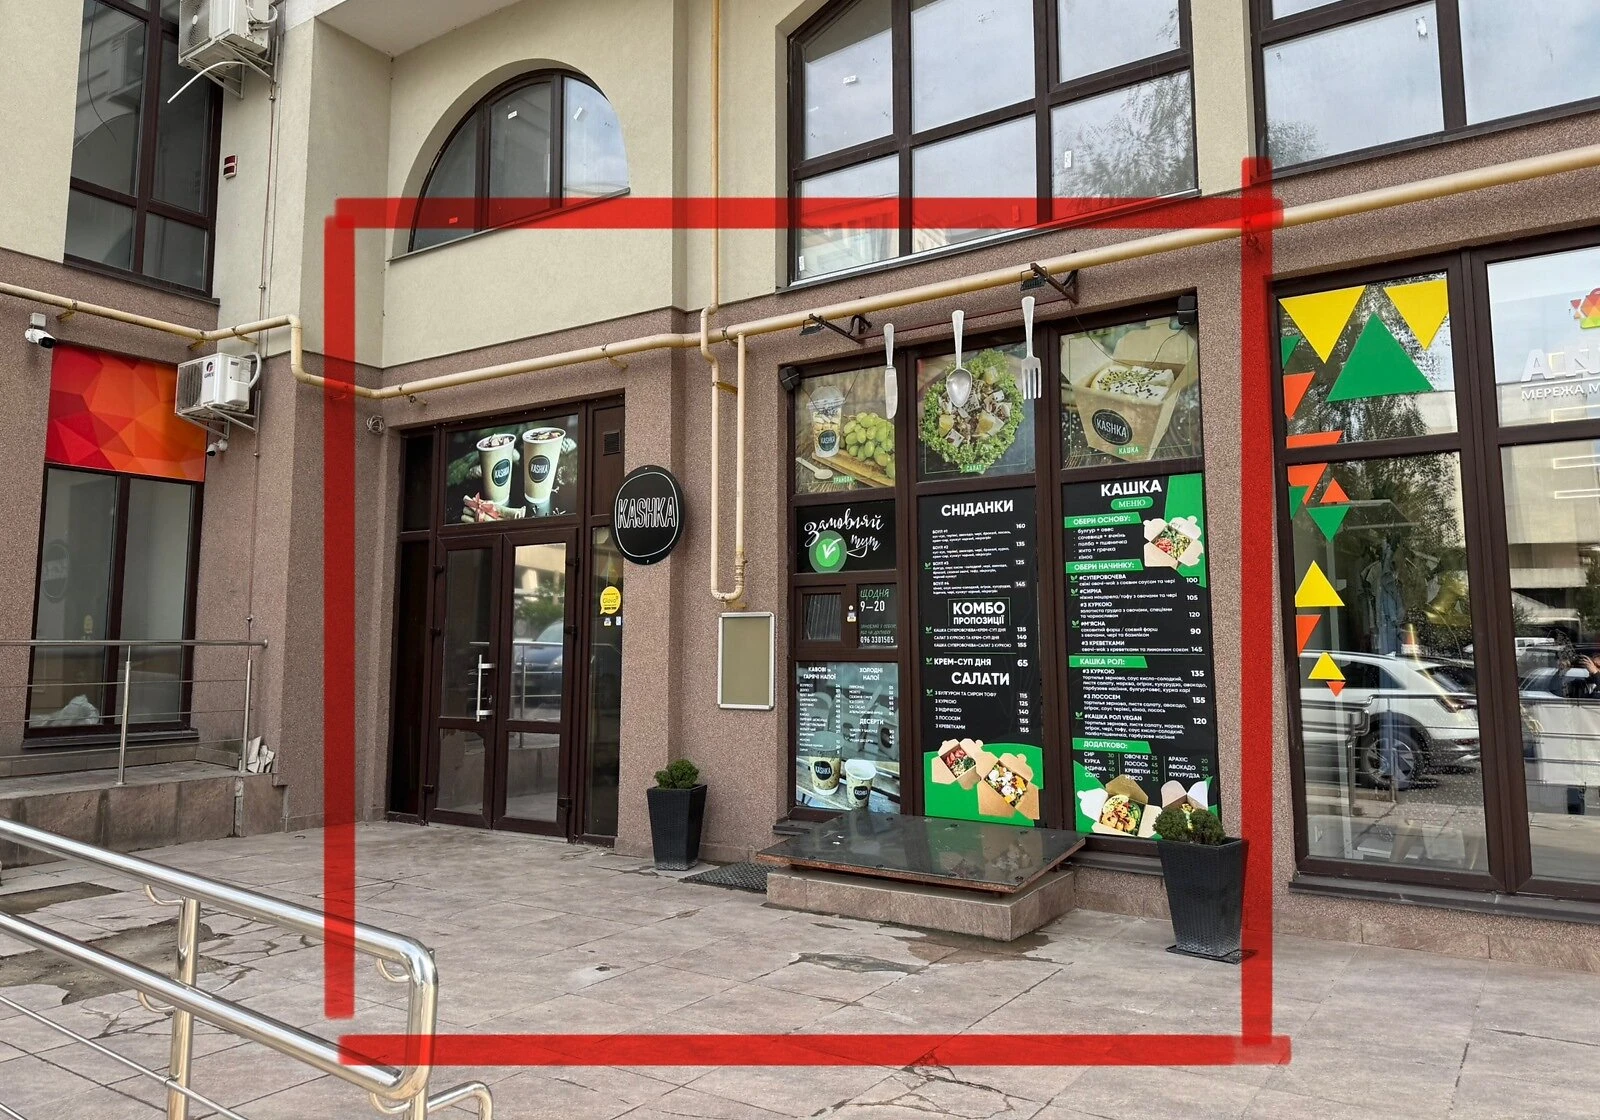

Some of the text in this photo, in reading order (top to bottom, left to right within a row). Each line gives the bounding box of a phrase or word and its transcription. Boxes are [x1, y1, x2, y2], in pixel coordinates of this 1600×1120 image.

[1522, 385, 1584, 400] МЕРЕЖА
[1097, 419, 1126, 438] KASHKA
[531, 464, 548, 473] KASHKA
[1101, 479, 1162, 497] КАШКА
[941, 500, 1014, 517] СНІДАНКИ
[1118, 499, 1146, 508] МЕНЮ
[618, 497, 675, 528] KASHKA
[1073, 516, 1131, 525] ОБЕРИ ОСНОВУ:
[804, 508, 884, 548] Замовляй
[1074, 562, 1135, 571] ОБЕРИ НАЧИНКУ:
[860, 588, 890, 600] ЩОДНЯ
[953, 601, 1006, 615] КОМБО
[953, 614, 1005, 625] ПРОПОЗИЦІЇ
[933, 658, 1029, 667] КРЕМ-СУП ДНЯ 65
[951, 672, 1010, 686] САЛАТИ
[1083, 741, 1128, 749] ДОДАТКОВО:
